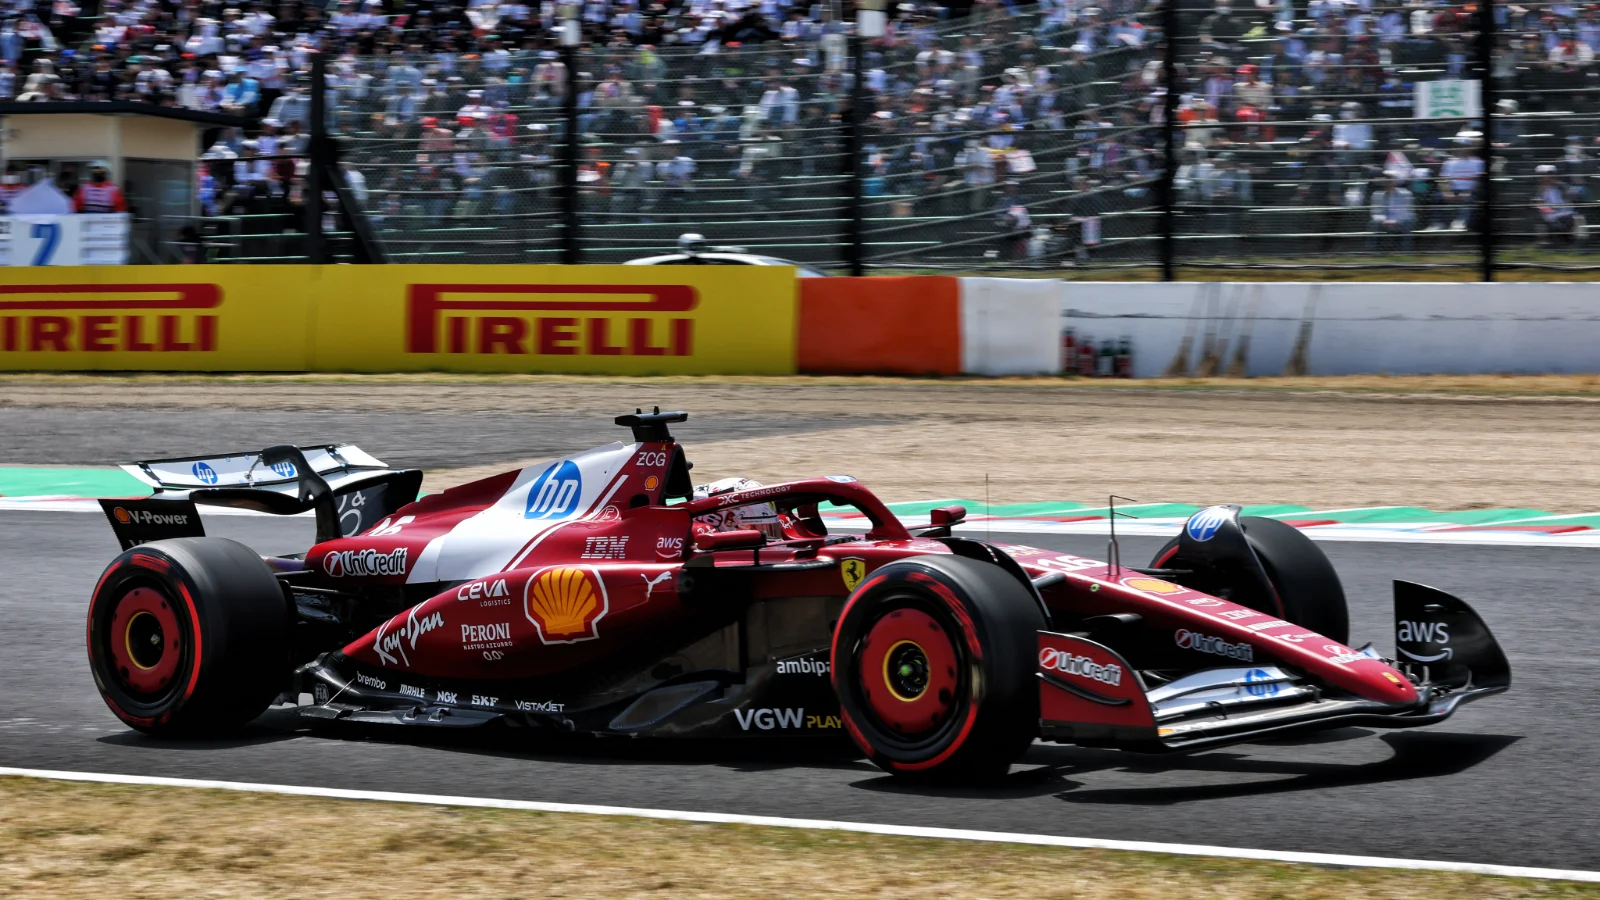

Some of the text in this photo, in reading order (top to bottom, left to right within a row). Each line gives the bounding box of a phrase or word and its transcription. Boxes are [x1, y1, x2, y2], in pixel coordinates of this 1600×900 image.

[404, 283, 701, 356] PIRELLI
[635, 452, 666, 467] ZCG
[527, 461, 579, 519] hp
[740, 485, 792, 499] TECHNOLOGY
[128, 510, 188, 525] V-Power
[1189, 510, 1220, 541] hp
[580, 535, 630, 559] IBM
[656, 537, 683, 549] aws
[340, 547, 408, 576] UniCredit
[479, 599, 511, 607] LOGISTICS
[461, 622, 511, 643] PERONI
[1397, 619, 1450, 644] aws
[1191, 633, 1254, 663] UniCredit
[1057, 651, 1122, 687] UniCredit
[356, 670, 387, 690] brembo
[399, 684, 426, 698] MAHLE
[436, 691, 458, 704] NGK
[471, 694, 499, 707] SKF
[733, 707, 804, 731] VGW
